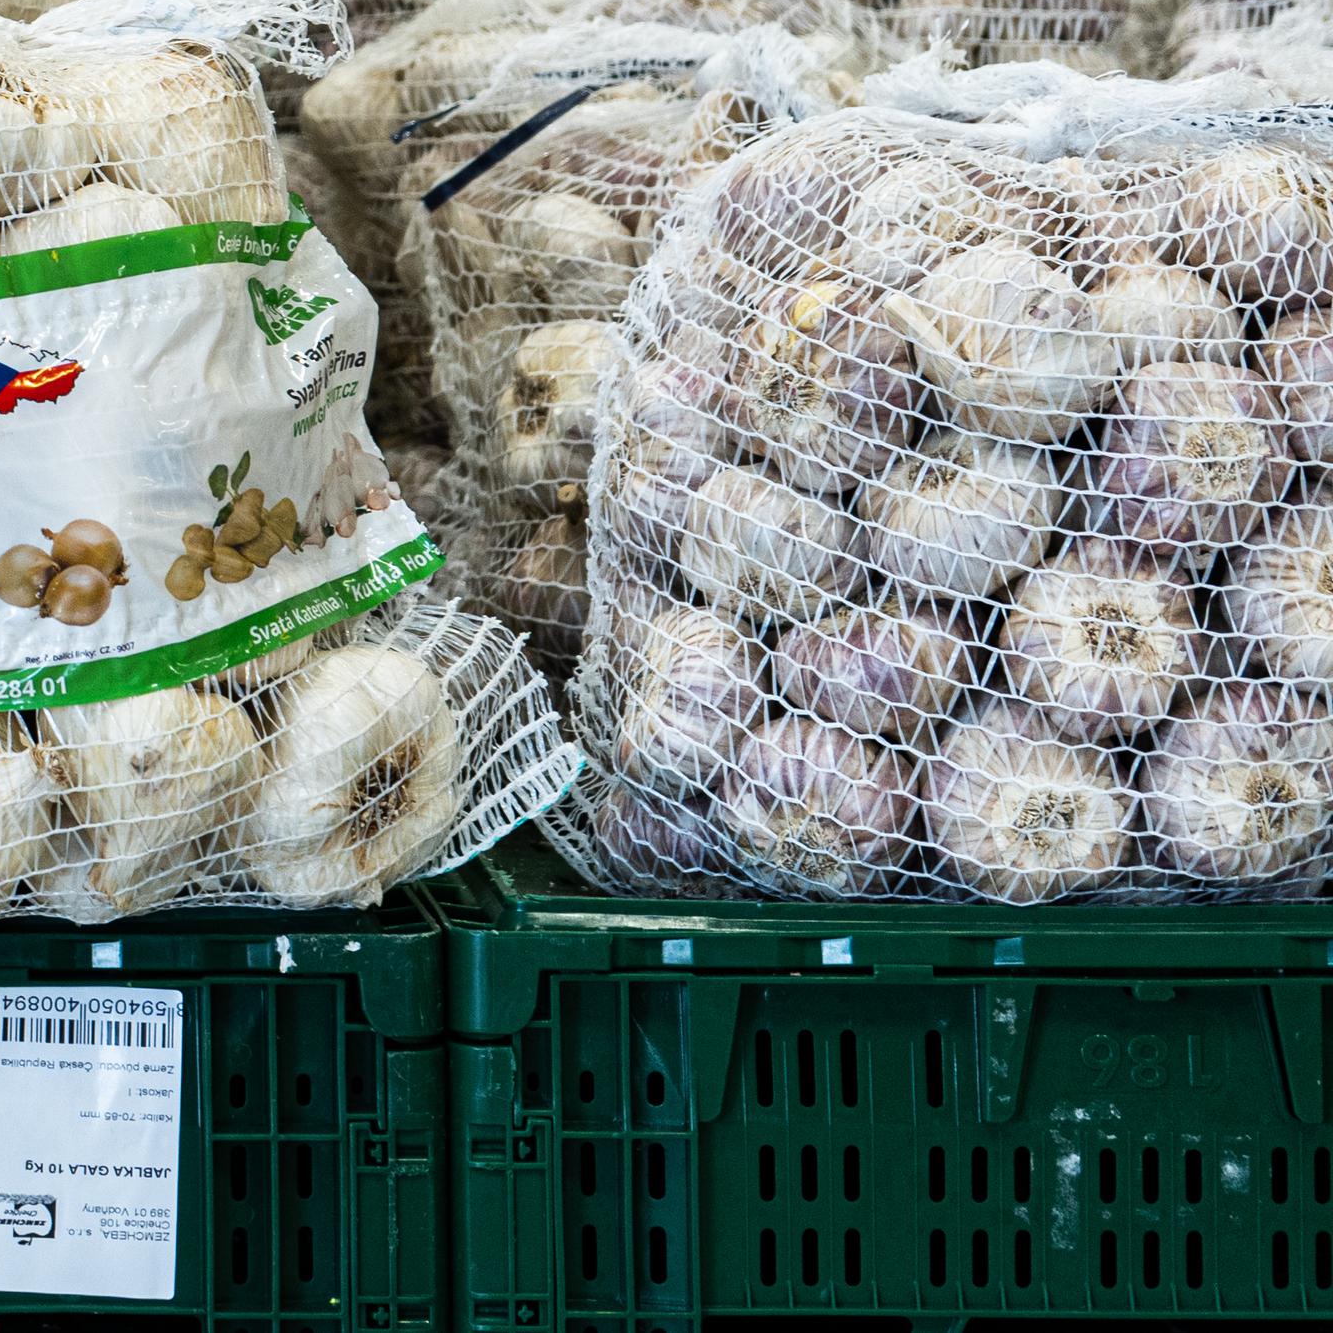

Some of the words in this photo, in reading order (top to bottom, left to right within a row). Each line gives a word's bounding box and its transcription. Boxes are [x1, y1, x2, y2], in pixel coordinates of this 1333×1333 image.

[249, 612, 294, 646] Svatá
[292, 596, 339, 628] Kateřina
[41, 676, 67, 696] 01
[2, 996, 78, 1013] 400894
[89, 998, 166, 1016] 594050
[1, 1057, 54, 1069] Republika
[59, 1061, 93, 1071] Česká
[136, 1088, 173, 1098] Jakost:
[80, 1110, 100, 1118] mm
[104, 1112, 135, 1121] 70-85
[140, 1113, 173, 1122] Kalibr:
[25, 1160, 43, 1173] Kg
[48, 1163, 64, 1174] 10
[69, 1164, 108, 1176] GALA
[114, 1165, 171, 1177] JABLKA
[82, 1204, 129, 1216] Vodňany
[134, 1208, 147, 1217] 01
[150, 1208, 170, 1218] 389
[100, 1219, 119, 1228] 106
[124, 1219, 170, 1230] Chelčice
